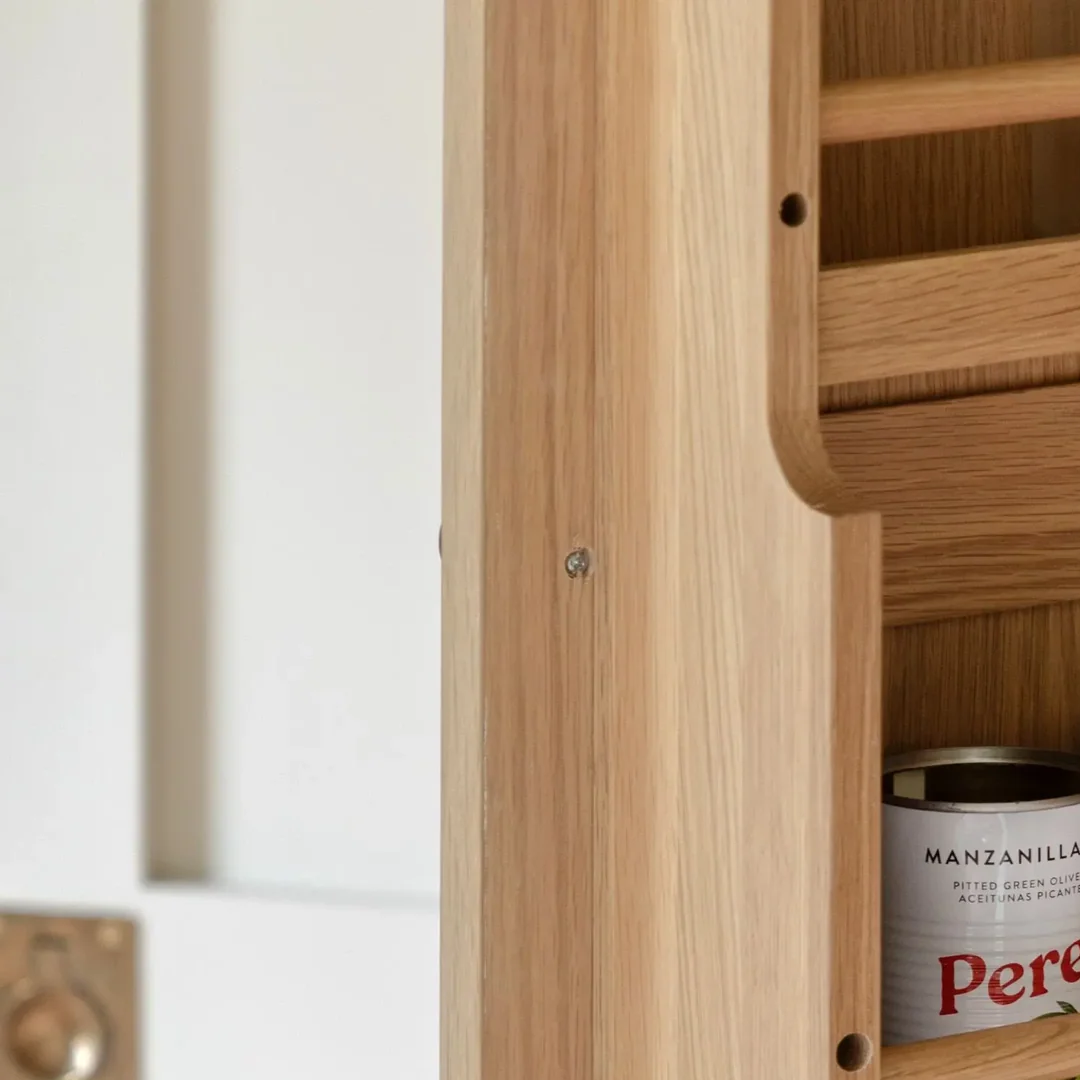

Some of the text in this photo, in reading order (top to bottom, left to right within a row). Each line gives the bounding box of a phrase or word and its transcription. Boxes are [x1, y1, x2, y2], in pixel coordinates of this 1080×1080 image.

[925, 842, 1080, 865] MANZANILLA
[953, 881, 998, 891] PITTED
[1003, 879, 1045, 890] GREEN
[958, 893, 1032, 904] ACEITUNAS
